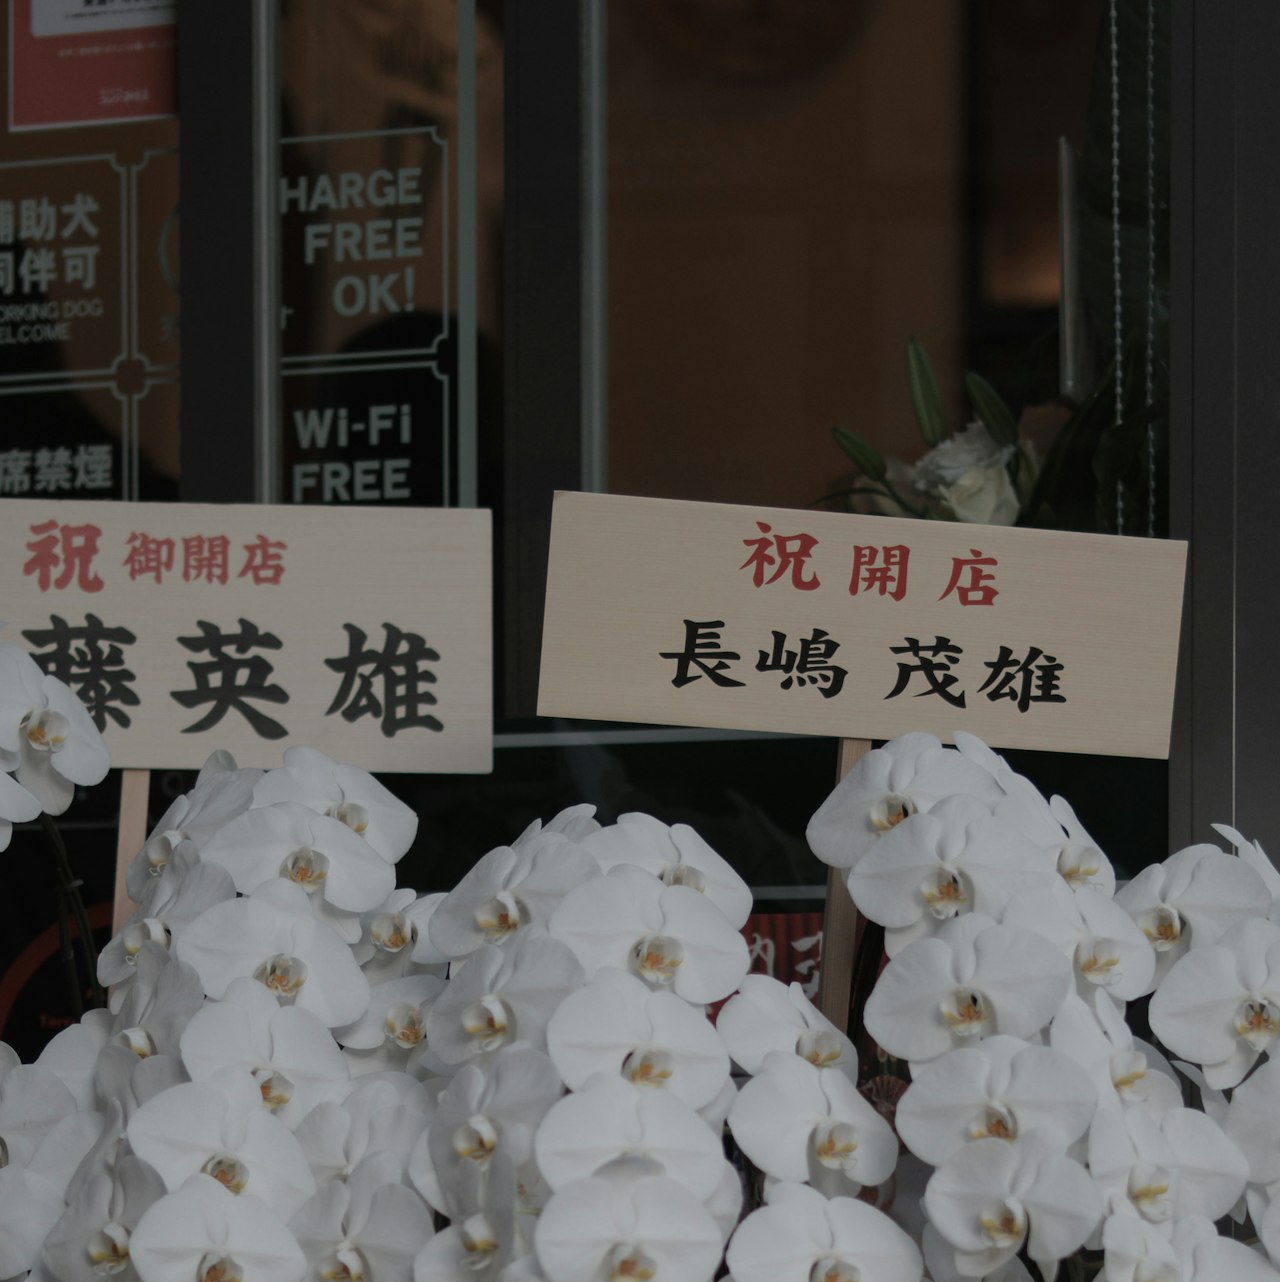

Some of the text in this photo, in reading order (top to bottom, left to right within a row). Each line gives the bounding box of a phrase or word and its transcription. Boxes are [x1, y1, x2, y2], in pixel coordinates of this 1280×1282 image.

[280, 167, 423, 213] HARGE
[303, 217, 424, 265] FREE
[63, 299, 104, 318] DOG
[332, 266, 416, 317] OK!
[292, 404, 412, 449] Wi-Fi
[291, 458, 412, 504] FREE
[740, 521, 1001, 607] 祝開店
